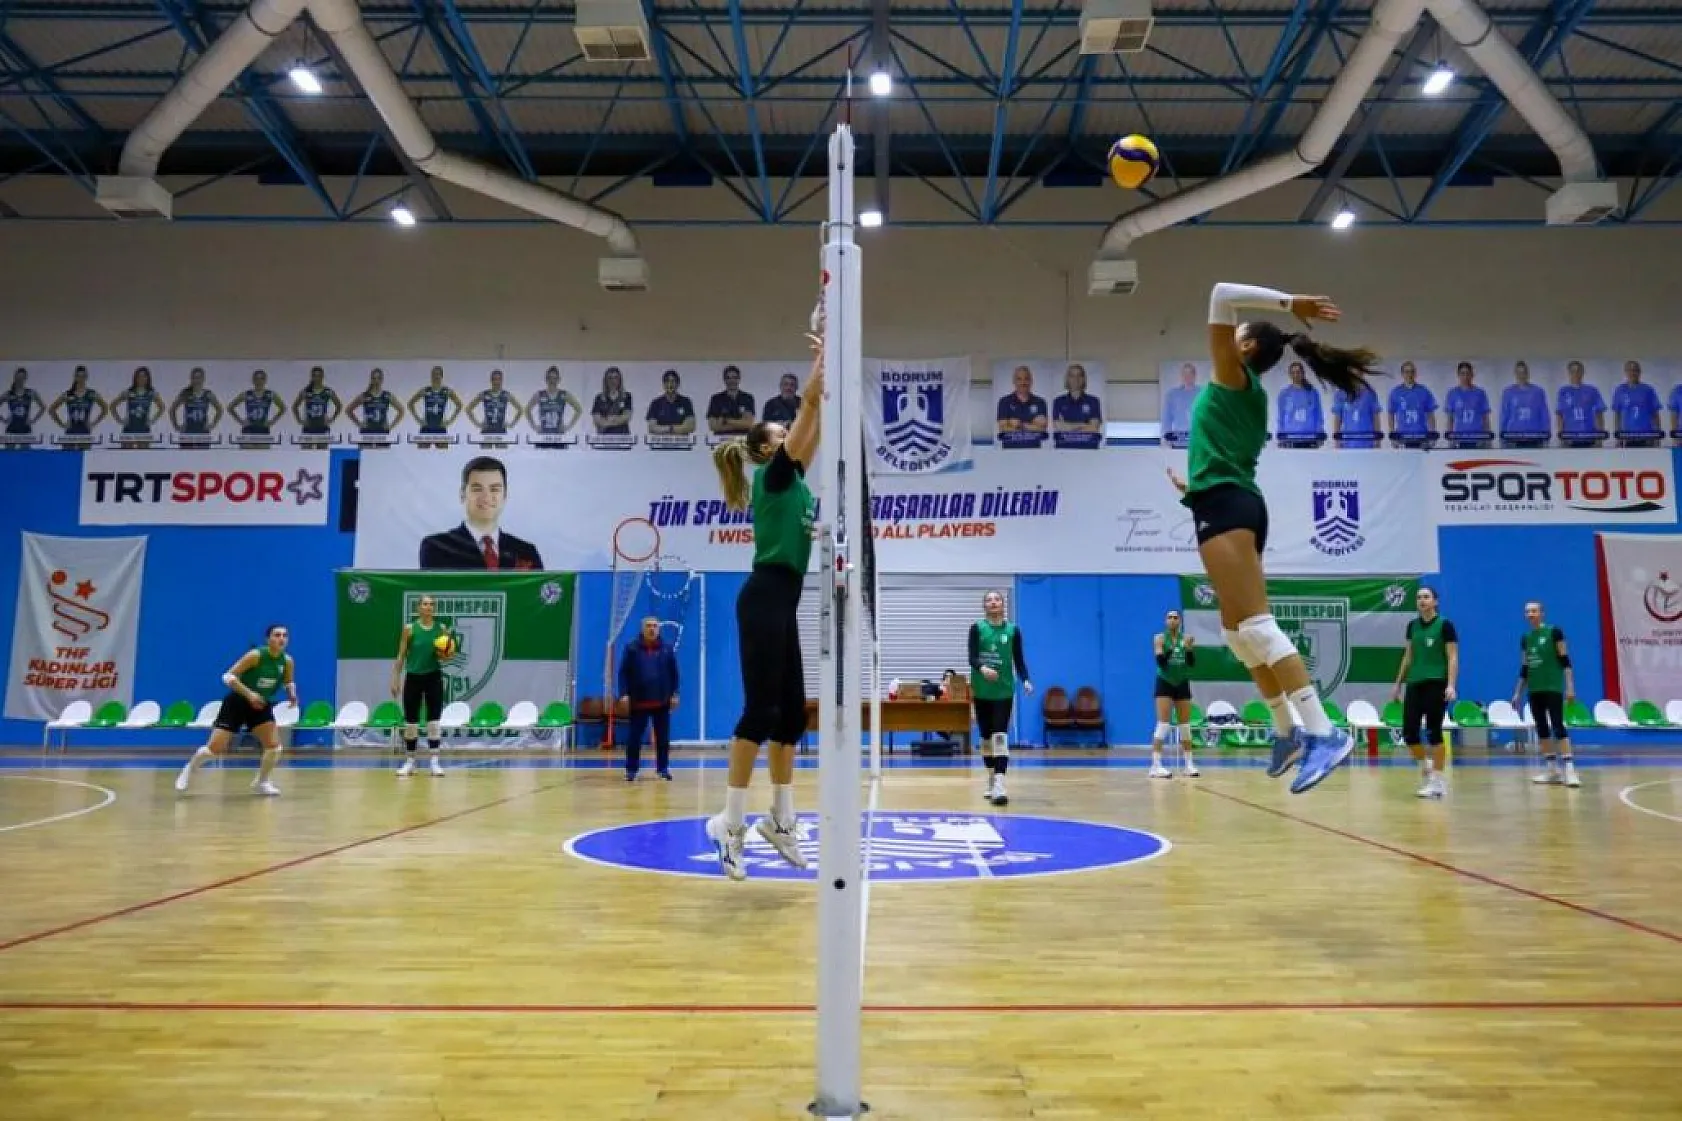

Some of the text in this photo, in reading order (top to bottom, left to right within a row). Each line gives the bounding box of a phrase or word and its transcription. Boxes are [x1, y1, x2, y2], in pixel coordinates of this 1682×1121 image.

[881, 371, 943, 382] BODRUM
[650, 495, 689, 526] TÜM
[979, 485, 1059, 517] DİLERİM
[717, 528, 754, 545] WIS
[882, 525, 914, 539] ALL
[917, 522, 997, 539] PLAYERS
